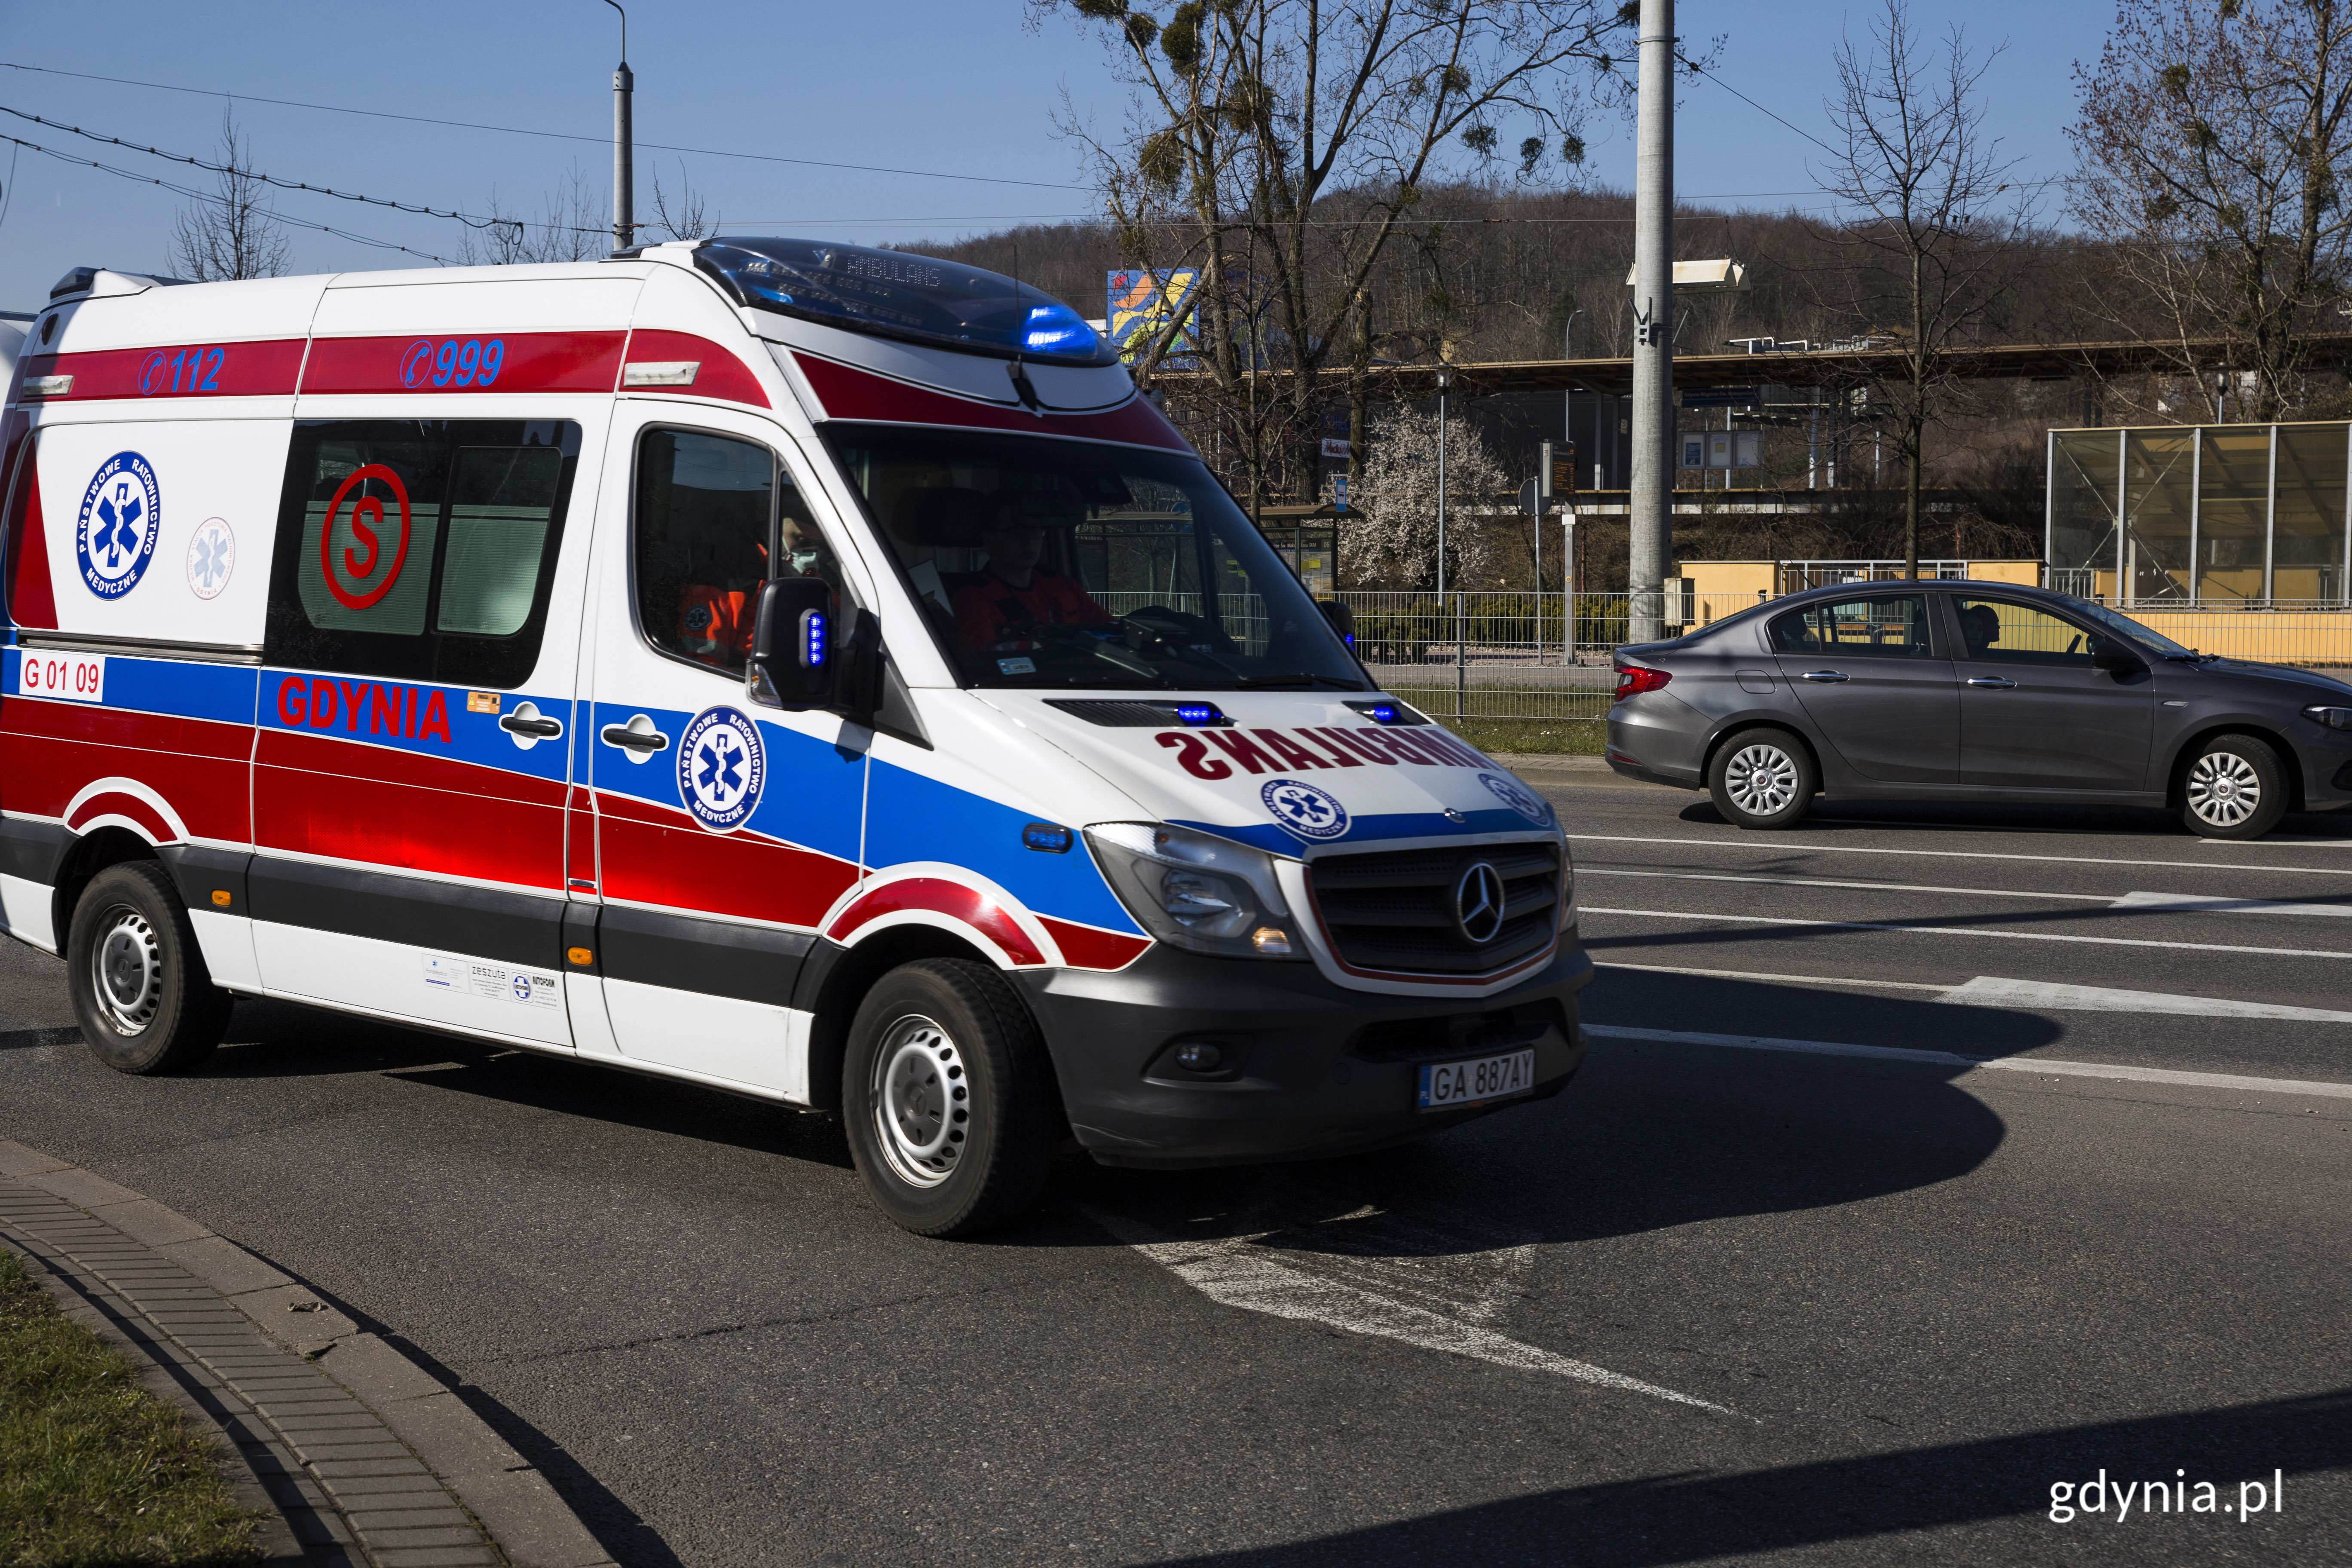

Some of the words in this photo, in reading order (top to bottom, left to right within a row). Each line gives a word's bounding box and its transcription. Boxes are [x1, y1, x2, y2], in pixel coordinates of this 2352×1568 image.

[848, 254, 940, 287] AMBULANS
[171, 348, 224, 392] 112
[433, 339, 505, 387] 999
[79, 459, 121, 553] PAŃSTWOWE
[132, 459, 158, 555] RATOWNICTWO
[345, 496, 383, 579] S
[86, 567, 138, 594] MEDYCZNE
[25, 658, 39, 688] G
[46, 660, 67, 690] 01
[76, 663, 98, 693] 09
[277, 676, 452, 743] GDYNIA
[681, 713, 718, 788] PAŃSTWOWE
[729, 714, 761, 794] RATOWNICTWO
[693, 800, 744, 823] MEDYCZNE
[1299, 821, 1344, 835] MEDYCZNE
[472, 966, 505, 979] zeszuta
[1435, 1065, 1467, 1100] GA
[1475, 1052, 1533, 1094] 887AY
